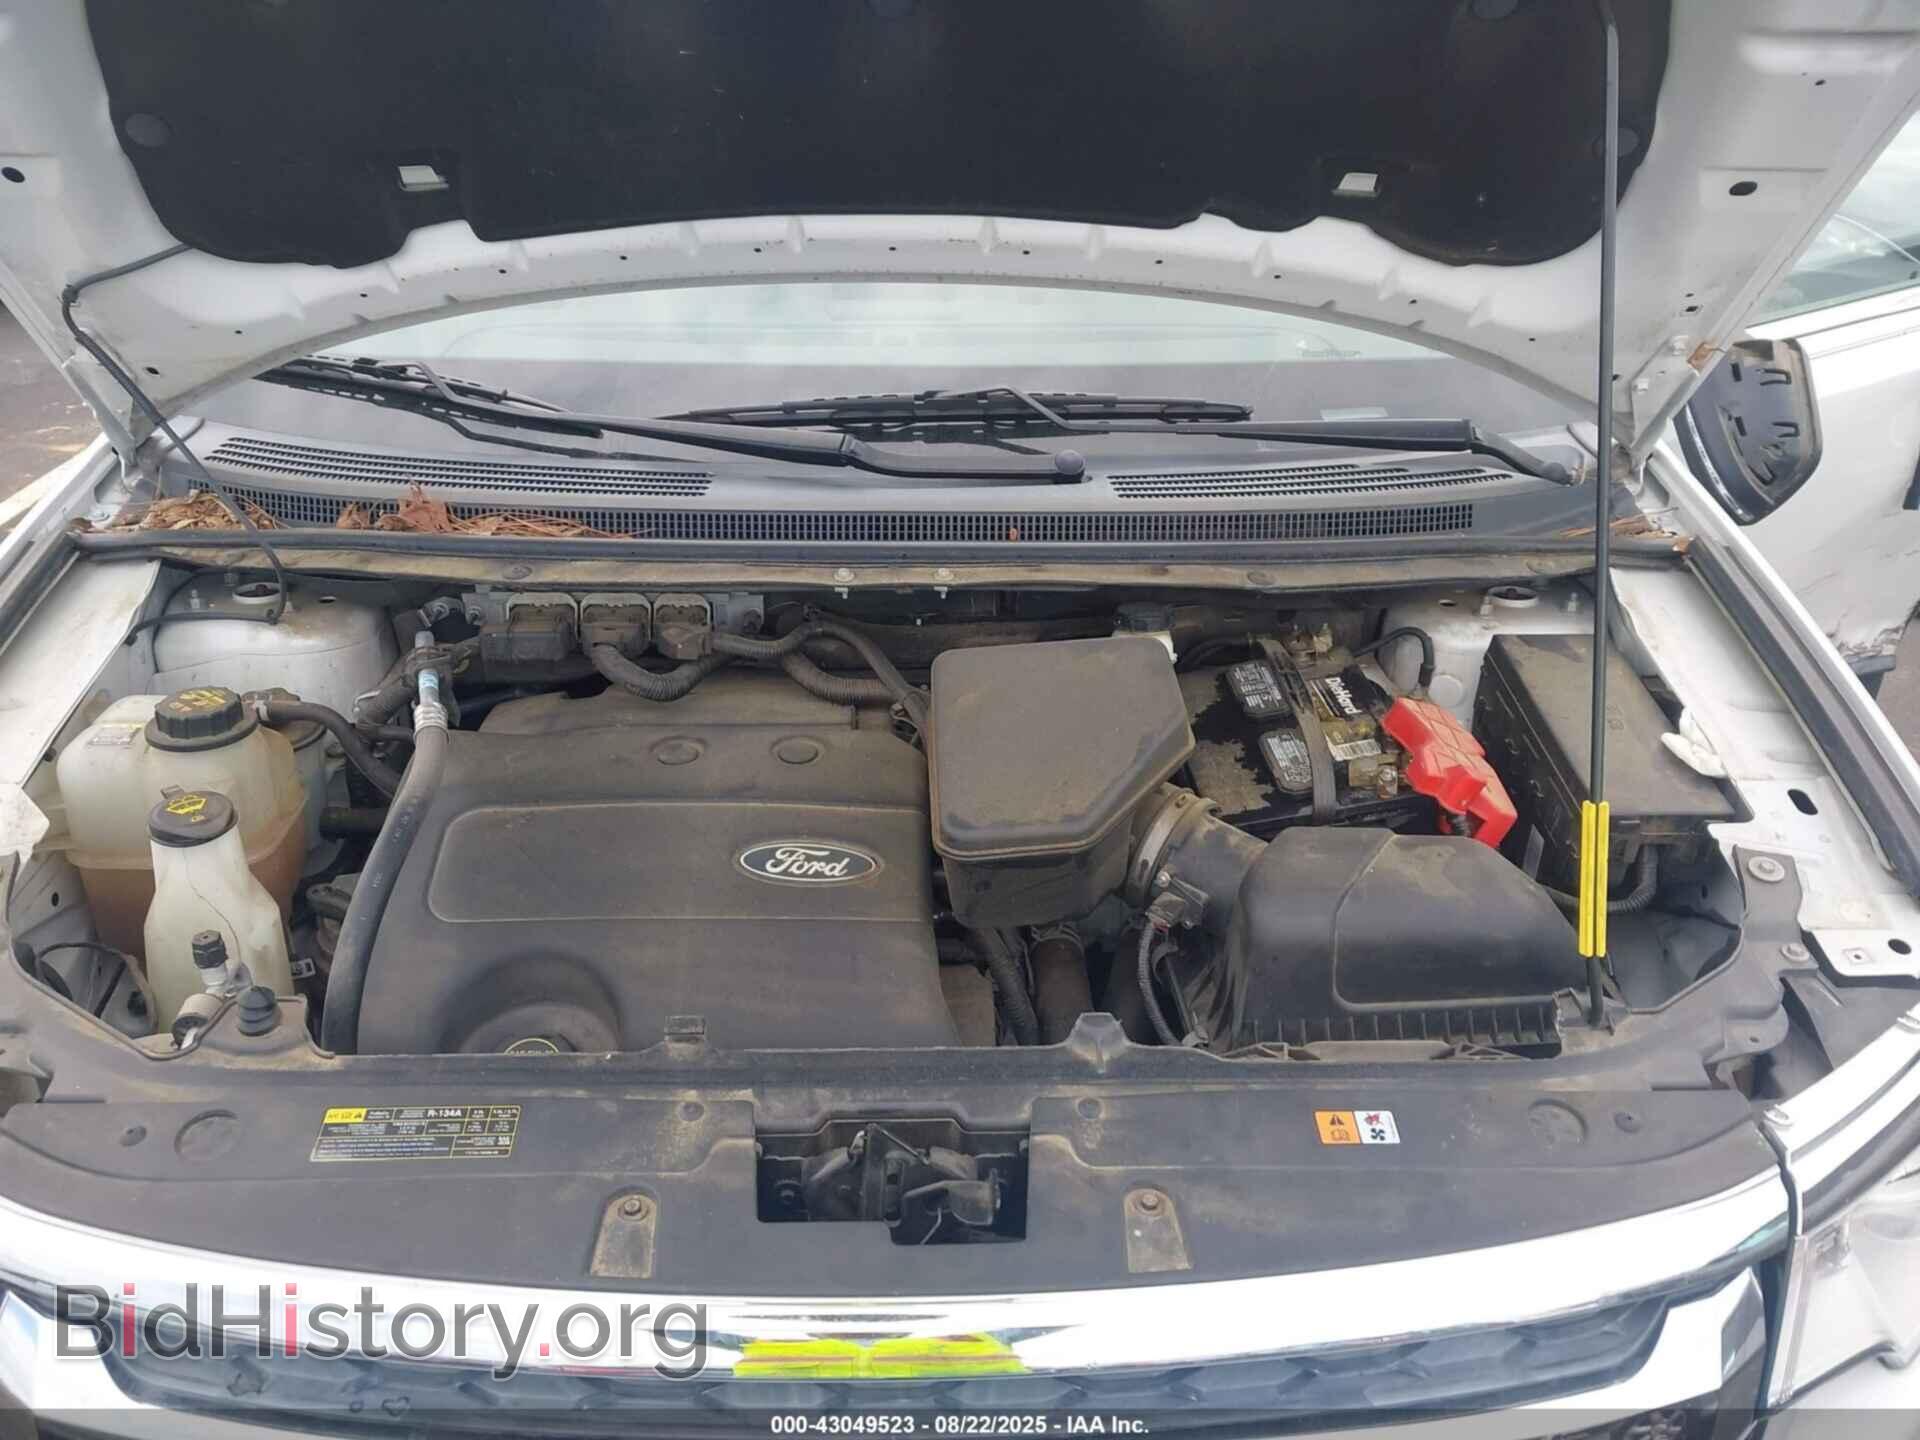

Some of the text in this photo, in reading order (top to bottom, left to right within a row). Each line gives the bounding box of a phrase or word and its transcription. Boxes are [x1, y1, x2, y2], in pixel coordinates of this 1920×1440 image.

[1324, 676, 1363, 716] DieHard
[765, 847, 850, 877] Ford
[426, 1109, 462, 1118] R-134A
